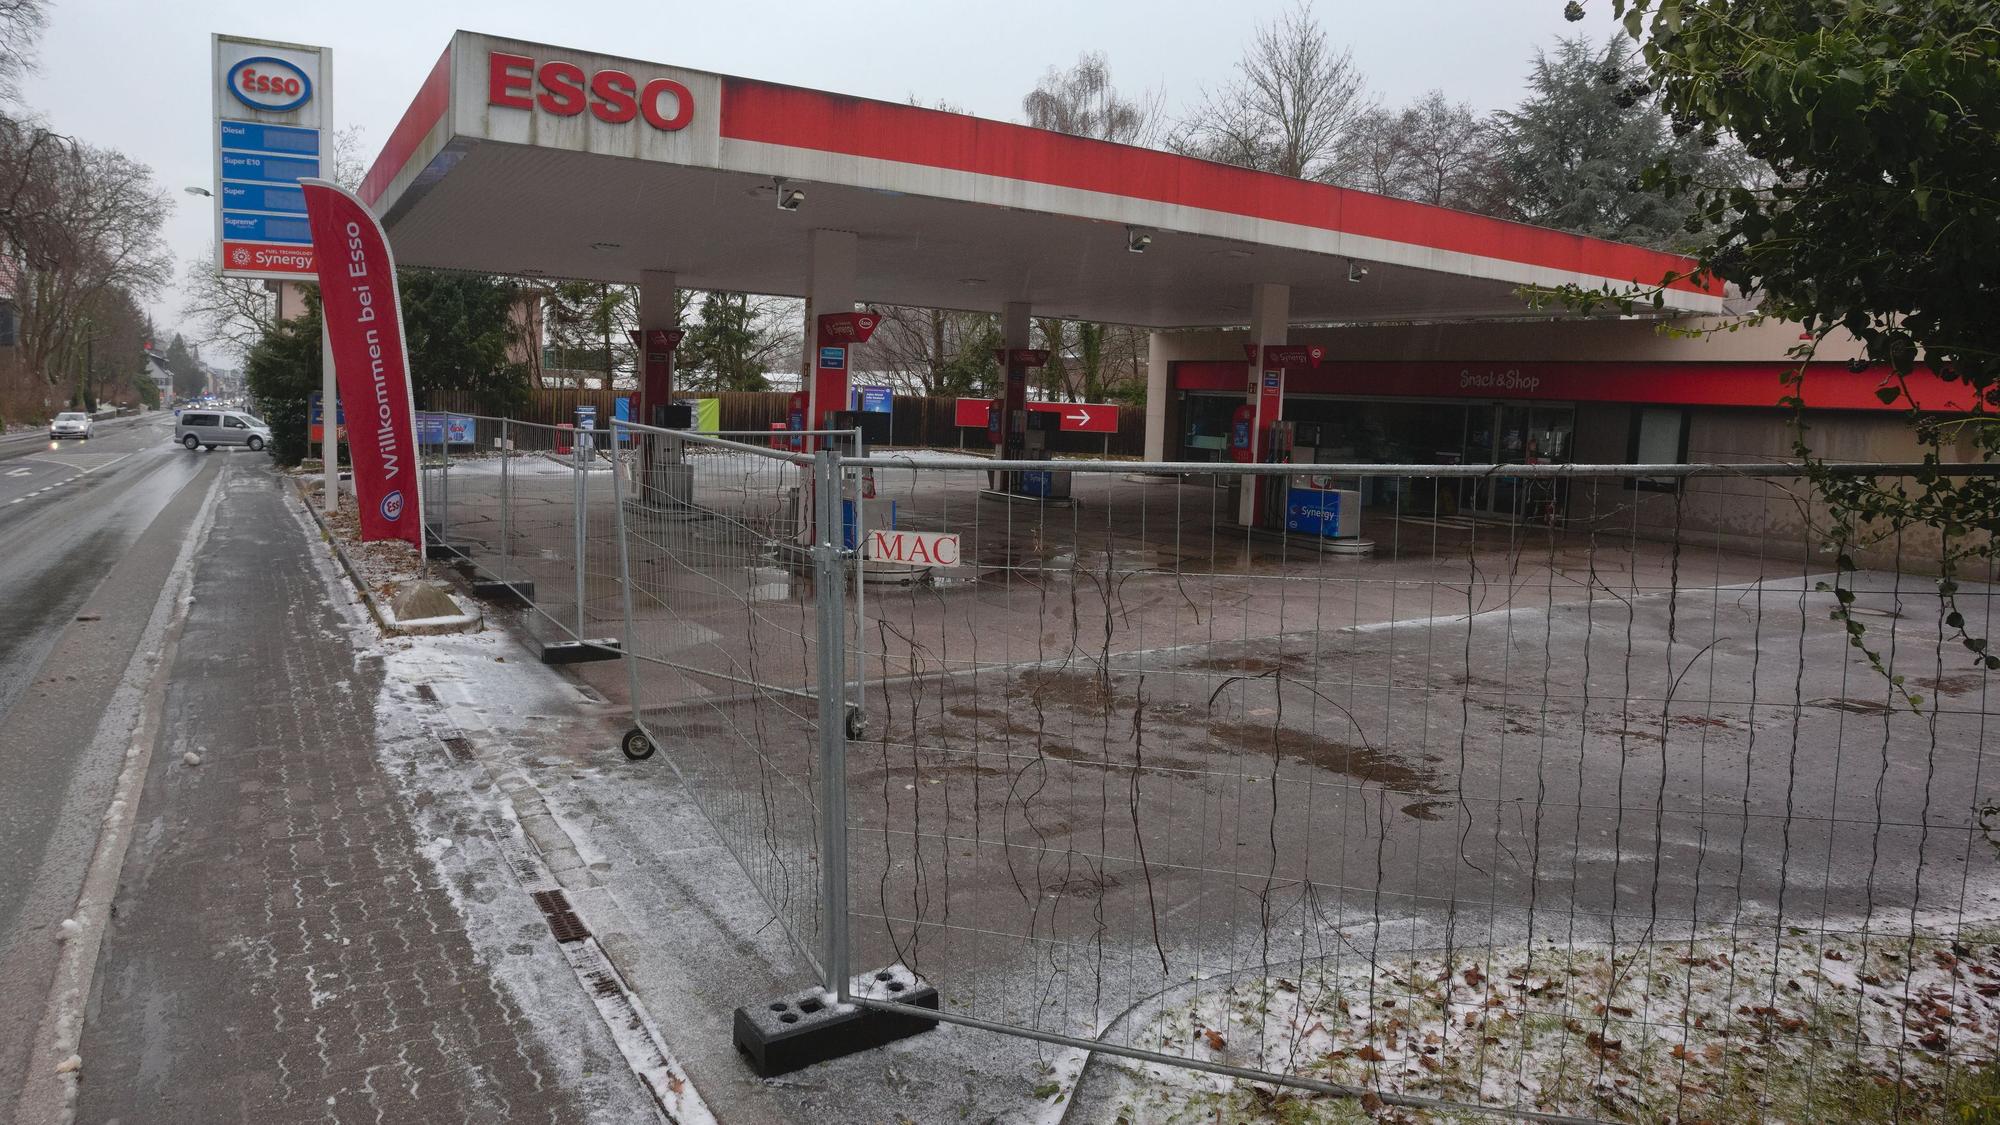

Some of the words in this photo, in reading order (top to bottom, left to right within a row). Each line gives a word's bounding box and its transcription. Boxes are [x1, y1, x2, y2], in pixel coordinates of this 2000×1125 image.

[242, 68, 299, 96] Esso
[489, 52, 695, 131] ESSO
[223, 126, 245, 135] Diesel
[224, 156, 246, 165] Super
[246, 158, 260, 167] E10
[224, 186, 245, 195] Super
[255, 251, 313, 269] Synergy
[346, 222, 368, 277] Esso
[357, 285, 375, 322] bei
[366, 330, 399, 480] Willkommen
[1301, 505, 1335, 520] Synergy
[876, 533, 957, 565] MAC
